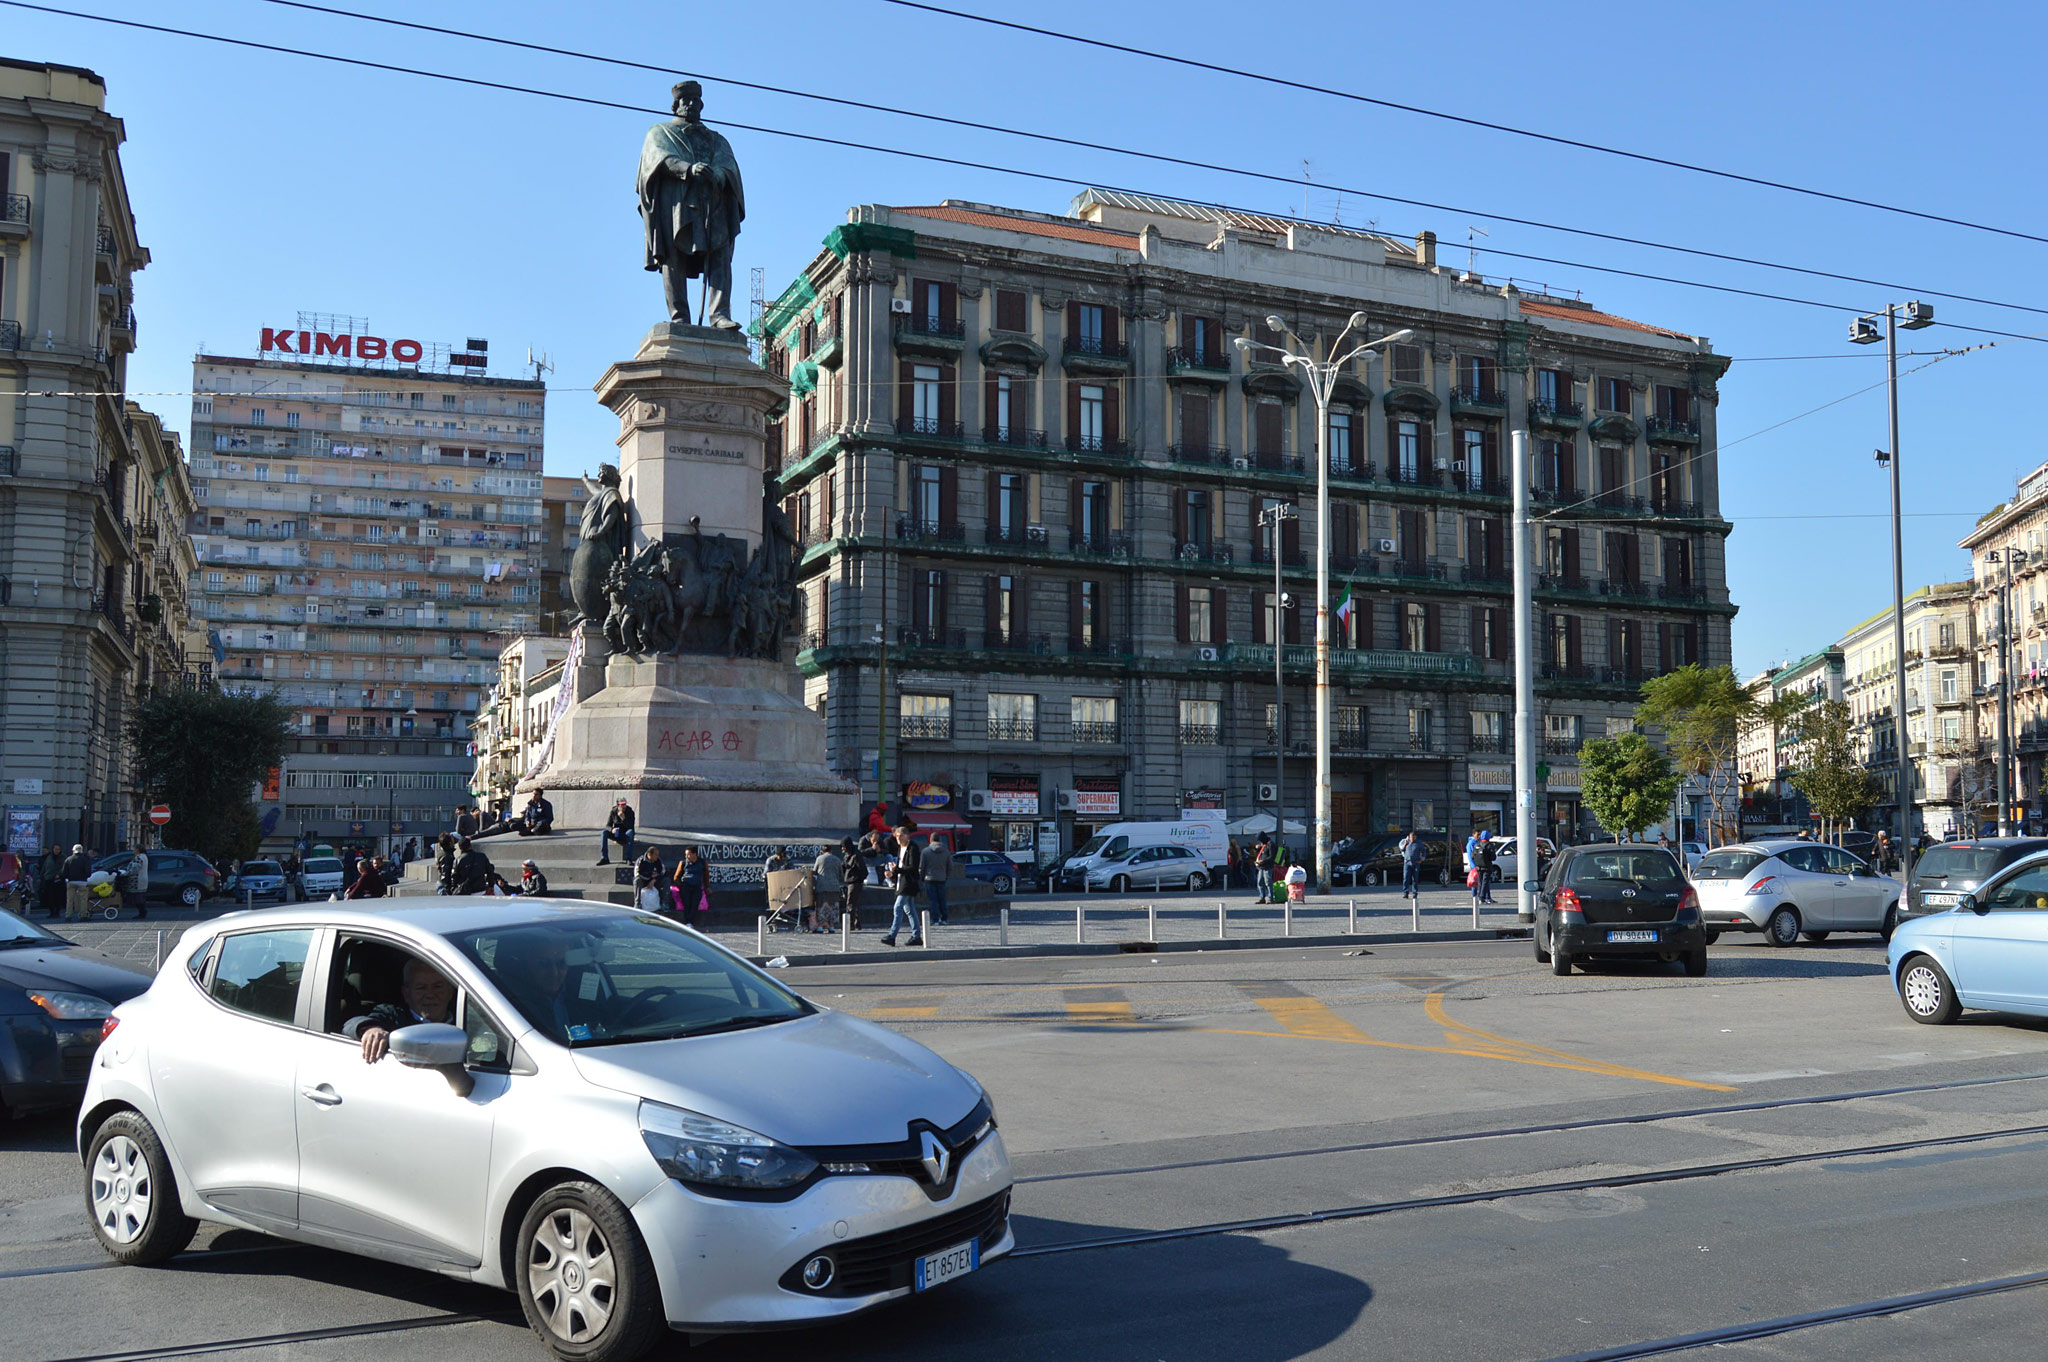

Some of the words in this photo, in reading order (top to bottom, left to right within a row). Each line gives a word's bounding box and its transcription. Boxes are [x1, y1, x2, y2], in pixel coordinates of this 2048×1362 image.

[262, 328, 423, 363] KIMBO
[658, 730, 714, 751] ACAB
[1470, 767, 1512, 785] Farmacia
[1547, 770, 1584, 786] Garibal
[1170, 827, 1196, 838] Hyria
[1613, 931, 1625, 940] DV
[1626, 931, 1651, 940] 904AV
[926, 1259, 938, 1282] ET
[941, 1247, 971, 1276] 857EX
